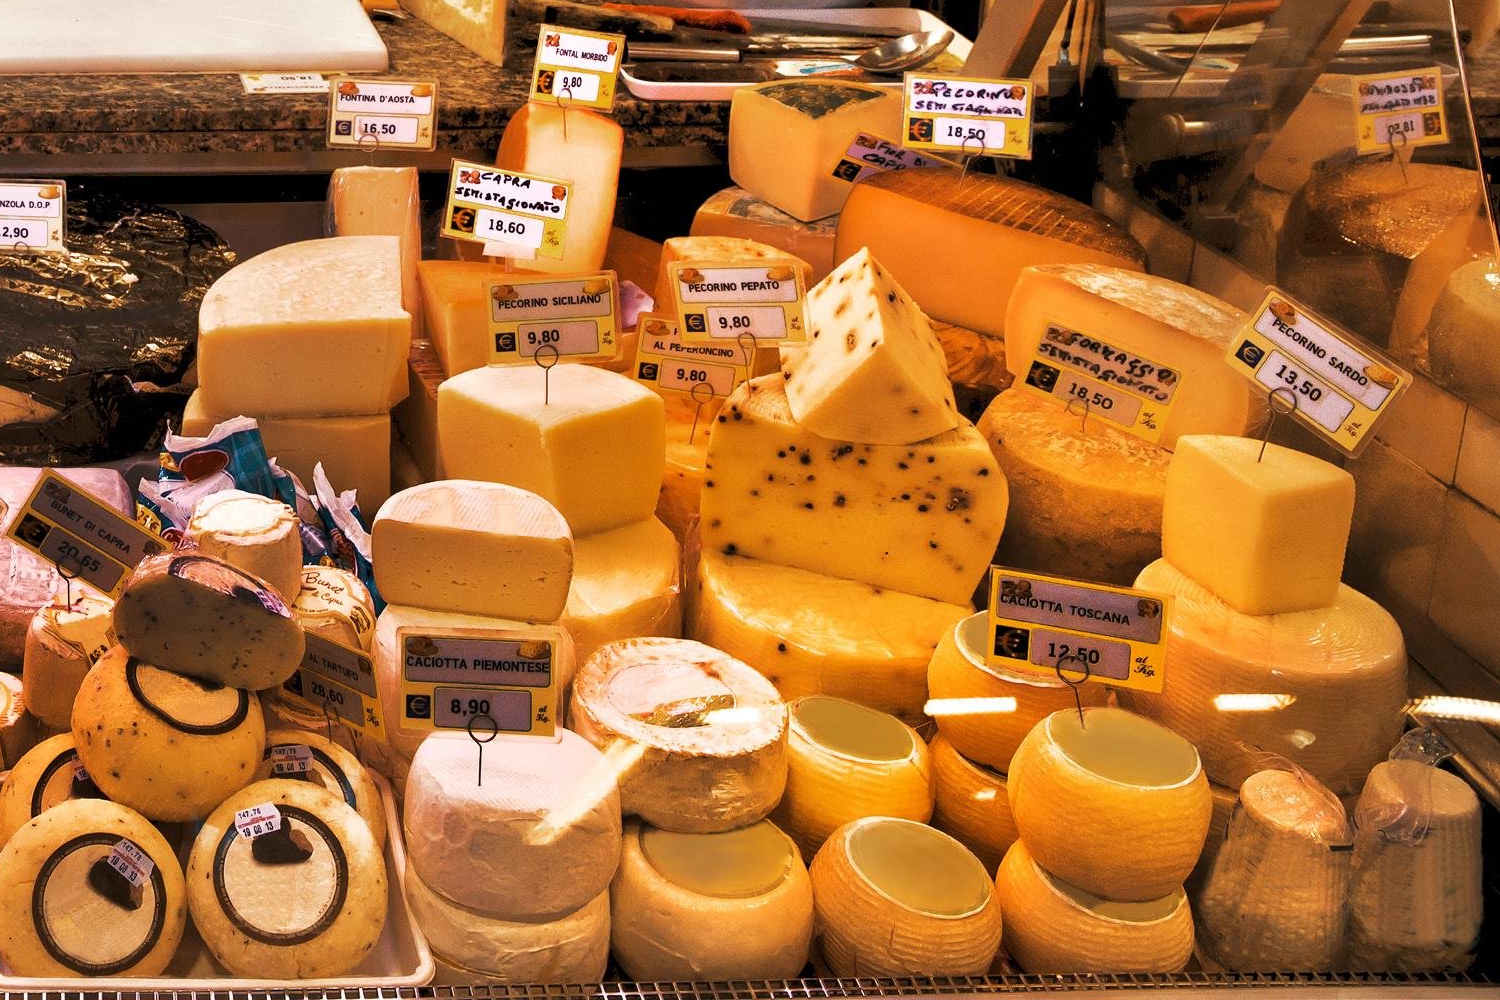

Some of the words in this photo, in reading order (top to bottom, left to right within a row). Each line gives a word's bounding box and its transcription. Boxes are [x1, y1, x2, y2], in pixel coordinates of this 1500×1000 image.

[556, 48, 579, 59] FONTAL
[581, 51, 608, 62] MORBIDO
[563, 76, 582, 88] 9,80
[340, 93, 376, 103] FONTINA
[379, 94, 415, 104] D'AOSTA
[481, 172, 531, 189] CAPRA
[488, 219, 526, 235] 18,60
[688, 281, 737, 293] PECORINO
[740, 280, 780, 291] PEPATO
[498, 297, 548, 310] PECORINO
[552, 294, 601, 306] SICILIANO
[718, 315, 750, 330] 9,80
[527, 329, 560, 345] 9,80
[653, 340, 665, 350] AL
[1272, 317, 1327, 359] PECORINO
[1328, 356, 1368, 387] SARDO
[676, 368, 707, 383] 9,80
[1275, 364, 1322, 402] 13,50
[51, 502, 84, 523] BUNET
[84, 521, 94, 532] DI
[97, 529, 131, 554] CAPRA
[302, 572, 345, 594] Bunet
[1000, 593, 1063, 613] CACIOTTA
[1069, 605, 1131, 626] TOSCANA
[308, 652, 319, 665] AL
[322, 658, 359, 681] TARTUFO
[406, 656, 468, 670] CACIOTTA
[473, 659, 550, 674] PIEMONTESE
[311, 681, 344, 705] 28,60
[450, 699, 490, 717] 8,90
[299, 762, 306, 770] 13
[242, 828, 251, 837] 19
[253, 824, 262, 834] 08
[265, 821, 274, 831] 13
[111, 855, 120, 865] 19
[119, 863, 129, 874] 08
[129, 871, 138, 881] 13
